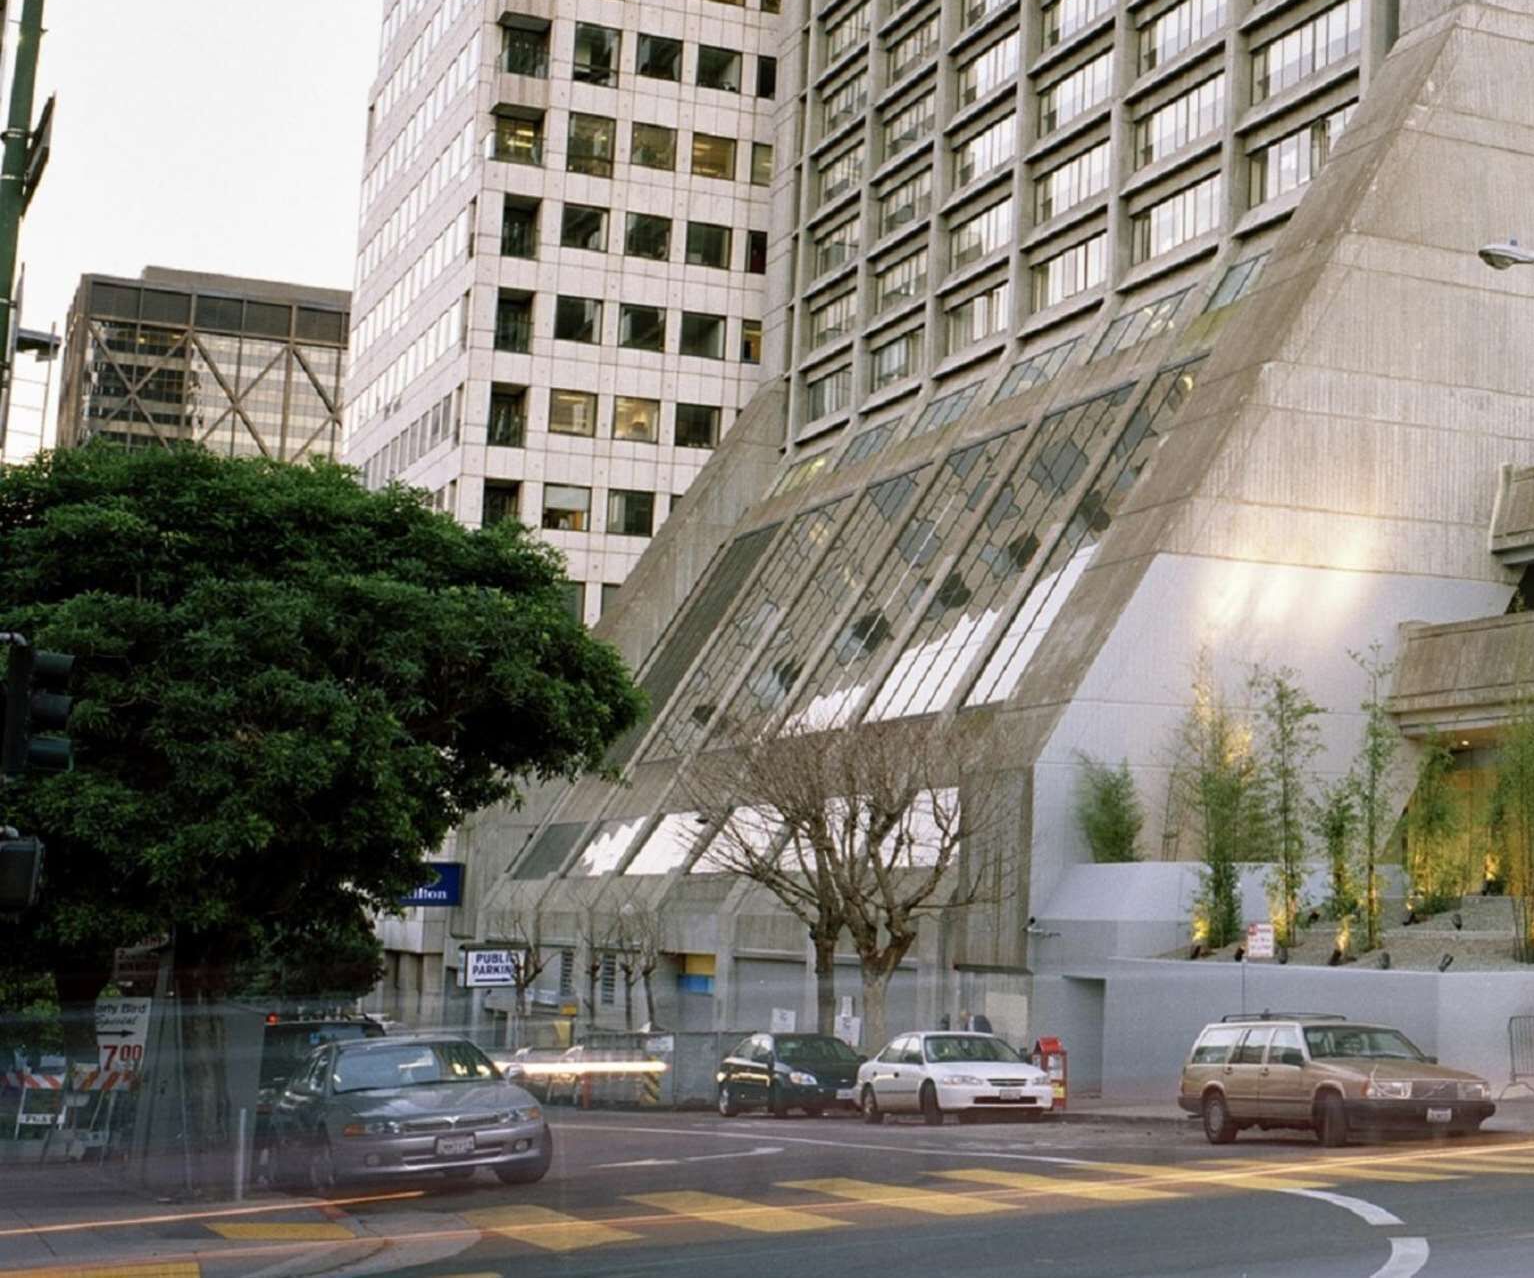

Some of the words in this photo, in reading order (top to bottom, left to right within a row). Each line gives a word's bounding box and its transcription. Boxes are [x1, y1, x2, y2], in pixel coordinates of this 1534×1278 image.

[401, 887, 448, 900] ilton
[475, 953, 517, 964] PUBLI
[472, 965, 517, 975] PARKIN
